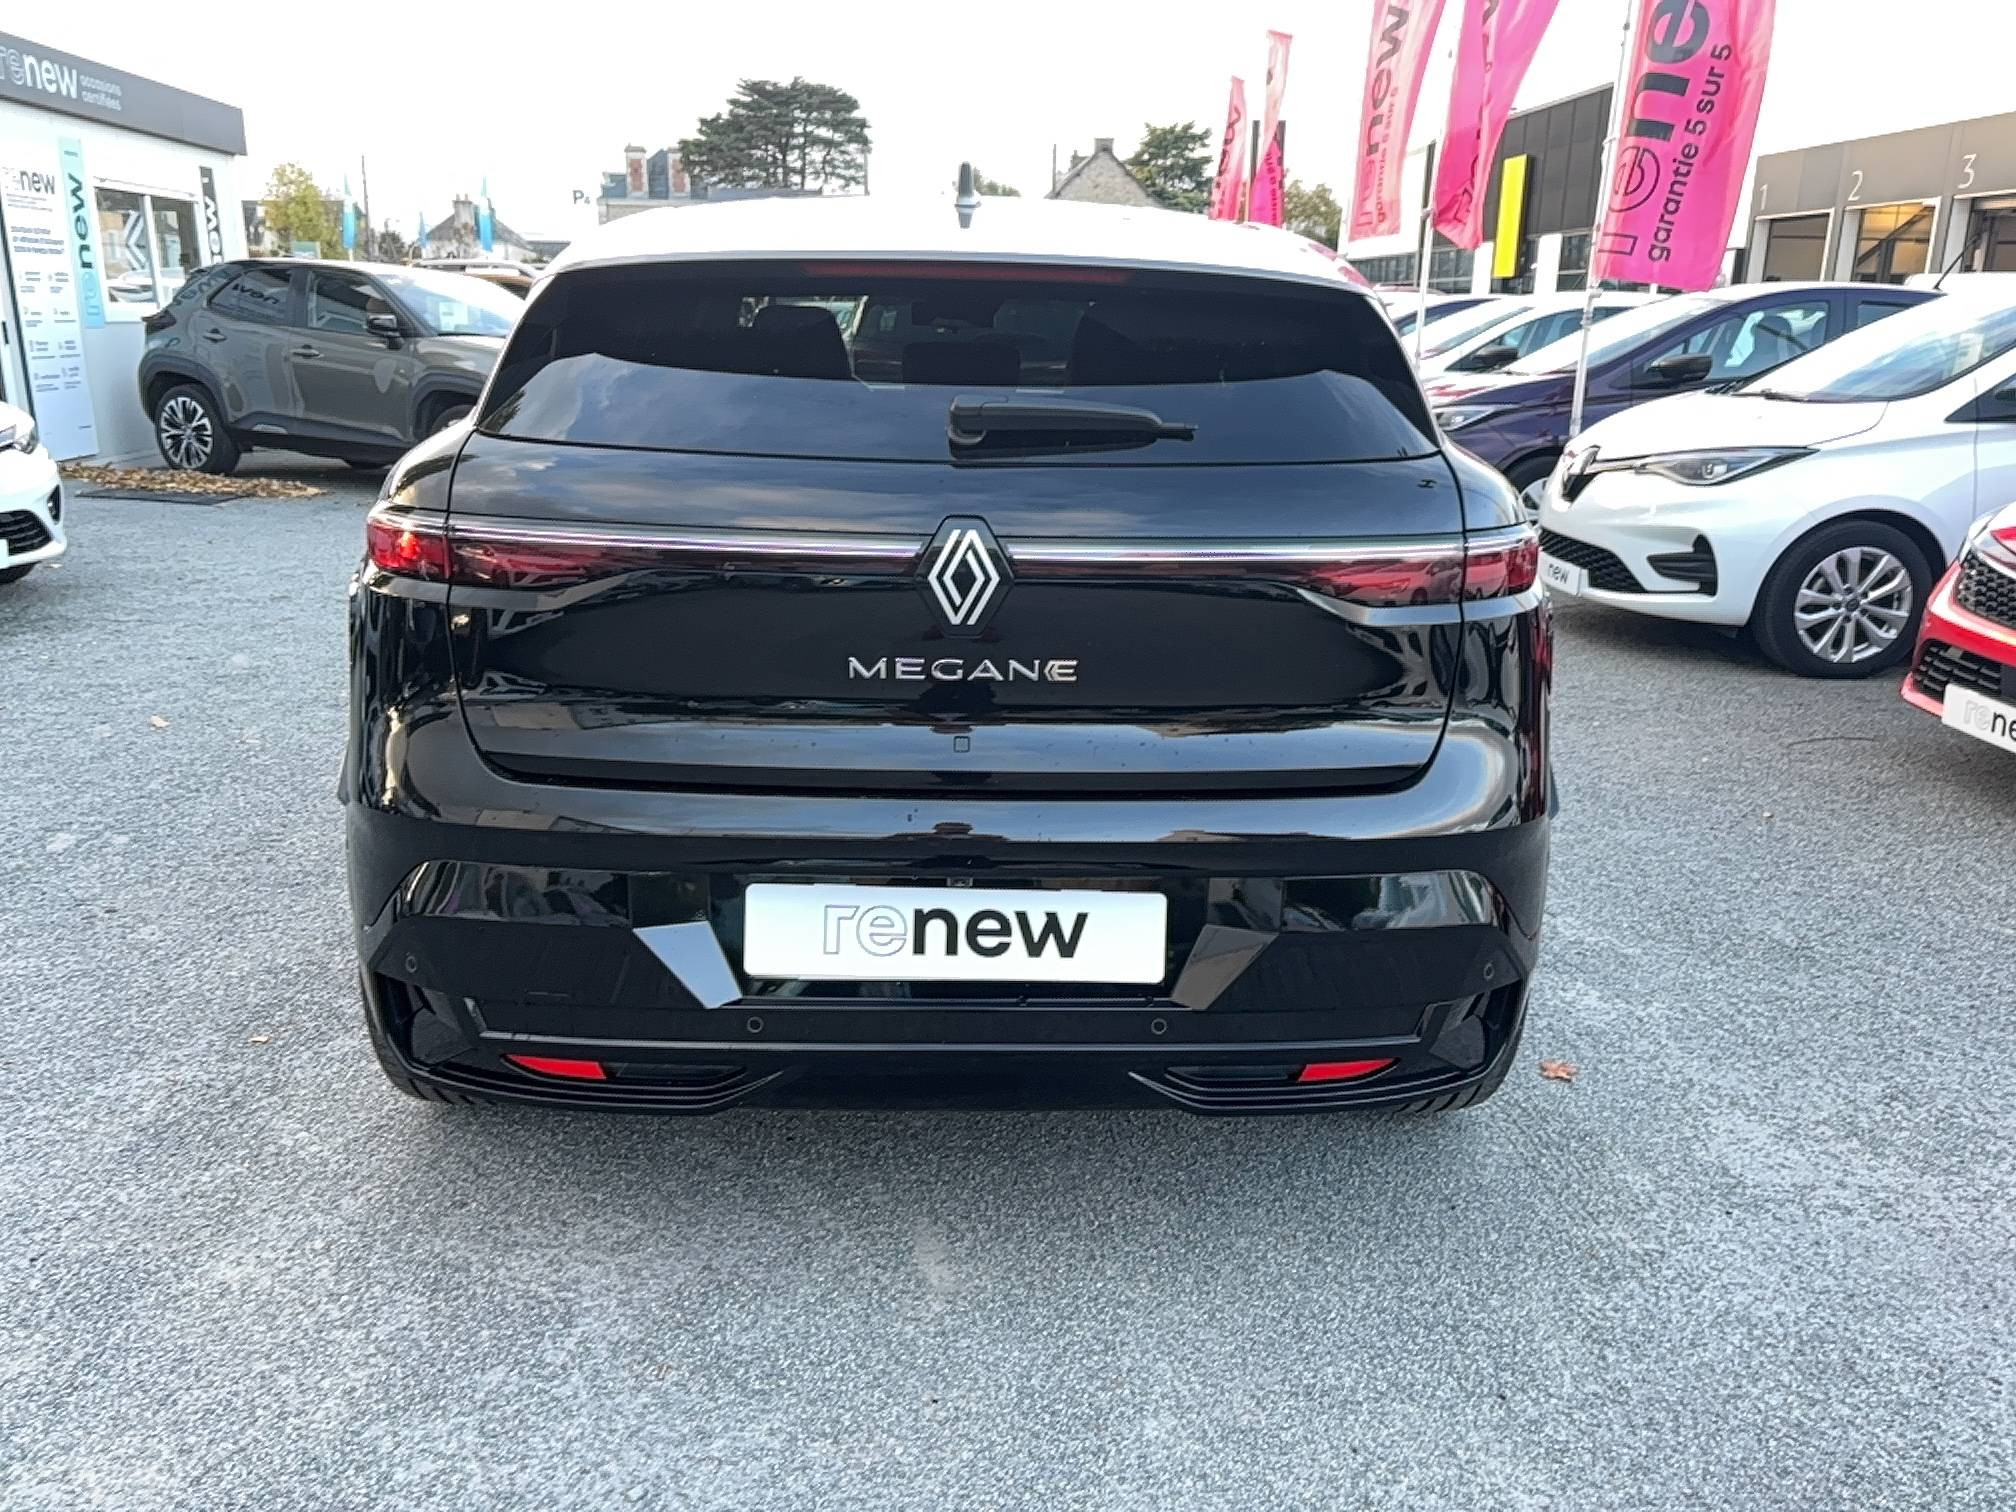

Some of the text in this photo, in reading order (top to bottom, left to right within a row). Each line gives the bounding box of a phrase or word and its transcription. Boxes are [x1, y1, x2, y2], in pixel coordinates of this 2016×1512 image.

[1648, 44, 1733, 262] garantie 5 sur 5
[1848, 170, 1863, 201] 2
[1958, 154, 1977, 189] 3
[1759, 184, 1769, 211] 1
[848, 656, 1079, 682] MEGANE
[823, 904, 1090, 958] renew
